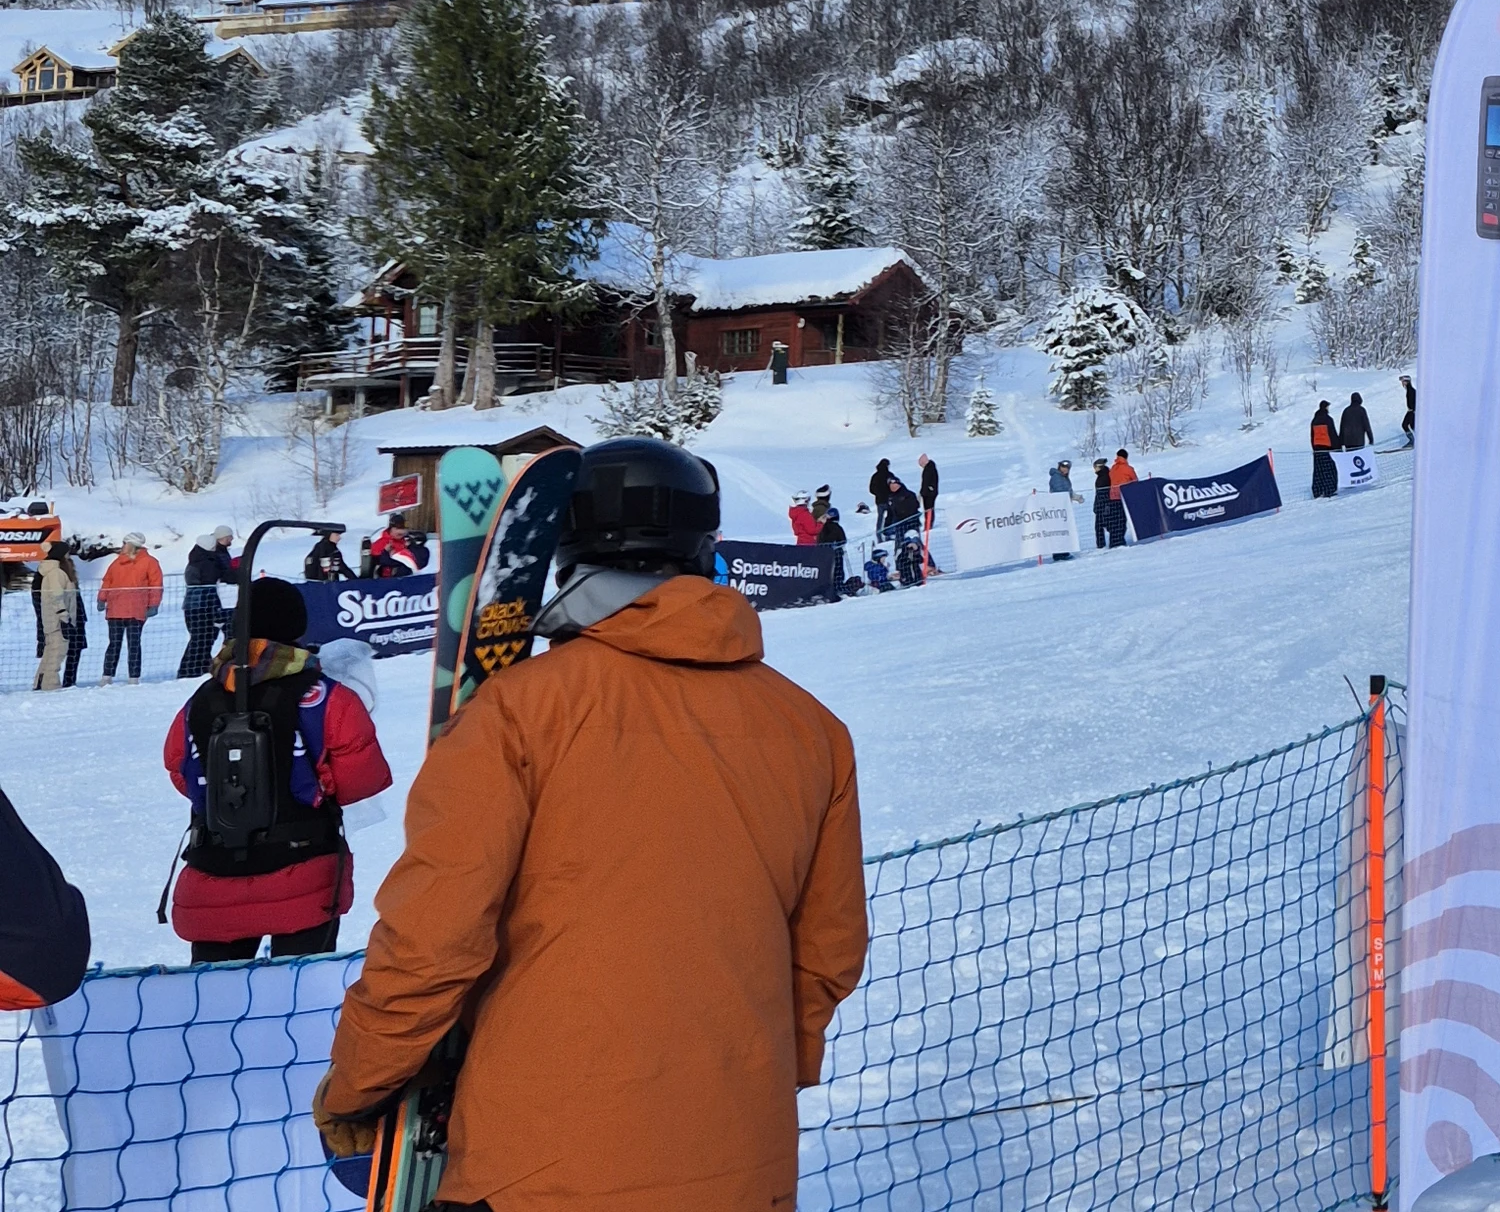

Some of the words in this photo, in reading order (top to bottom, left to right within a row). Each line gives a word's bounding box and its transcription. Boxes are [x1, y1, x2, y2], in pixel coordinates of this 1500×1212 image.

[1163, 481, 1238, 509] Stranda
[731, 558, 820, 579] Sparebanken
[730, 579, 768, 596] Møre
[337, 585, 440, 627] Strand
